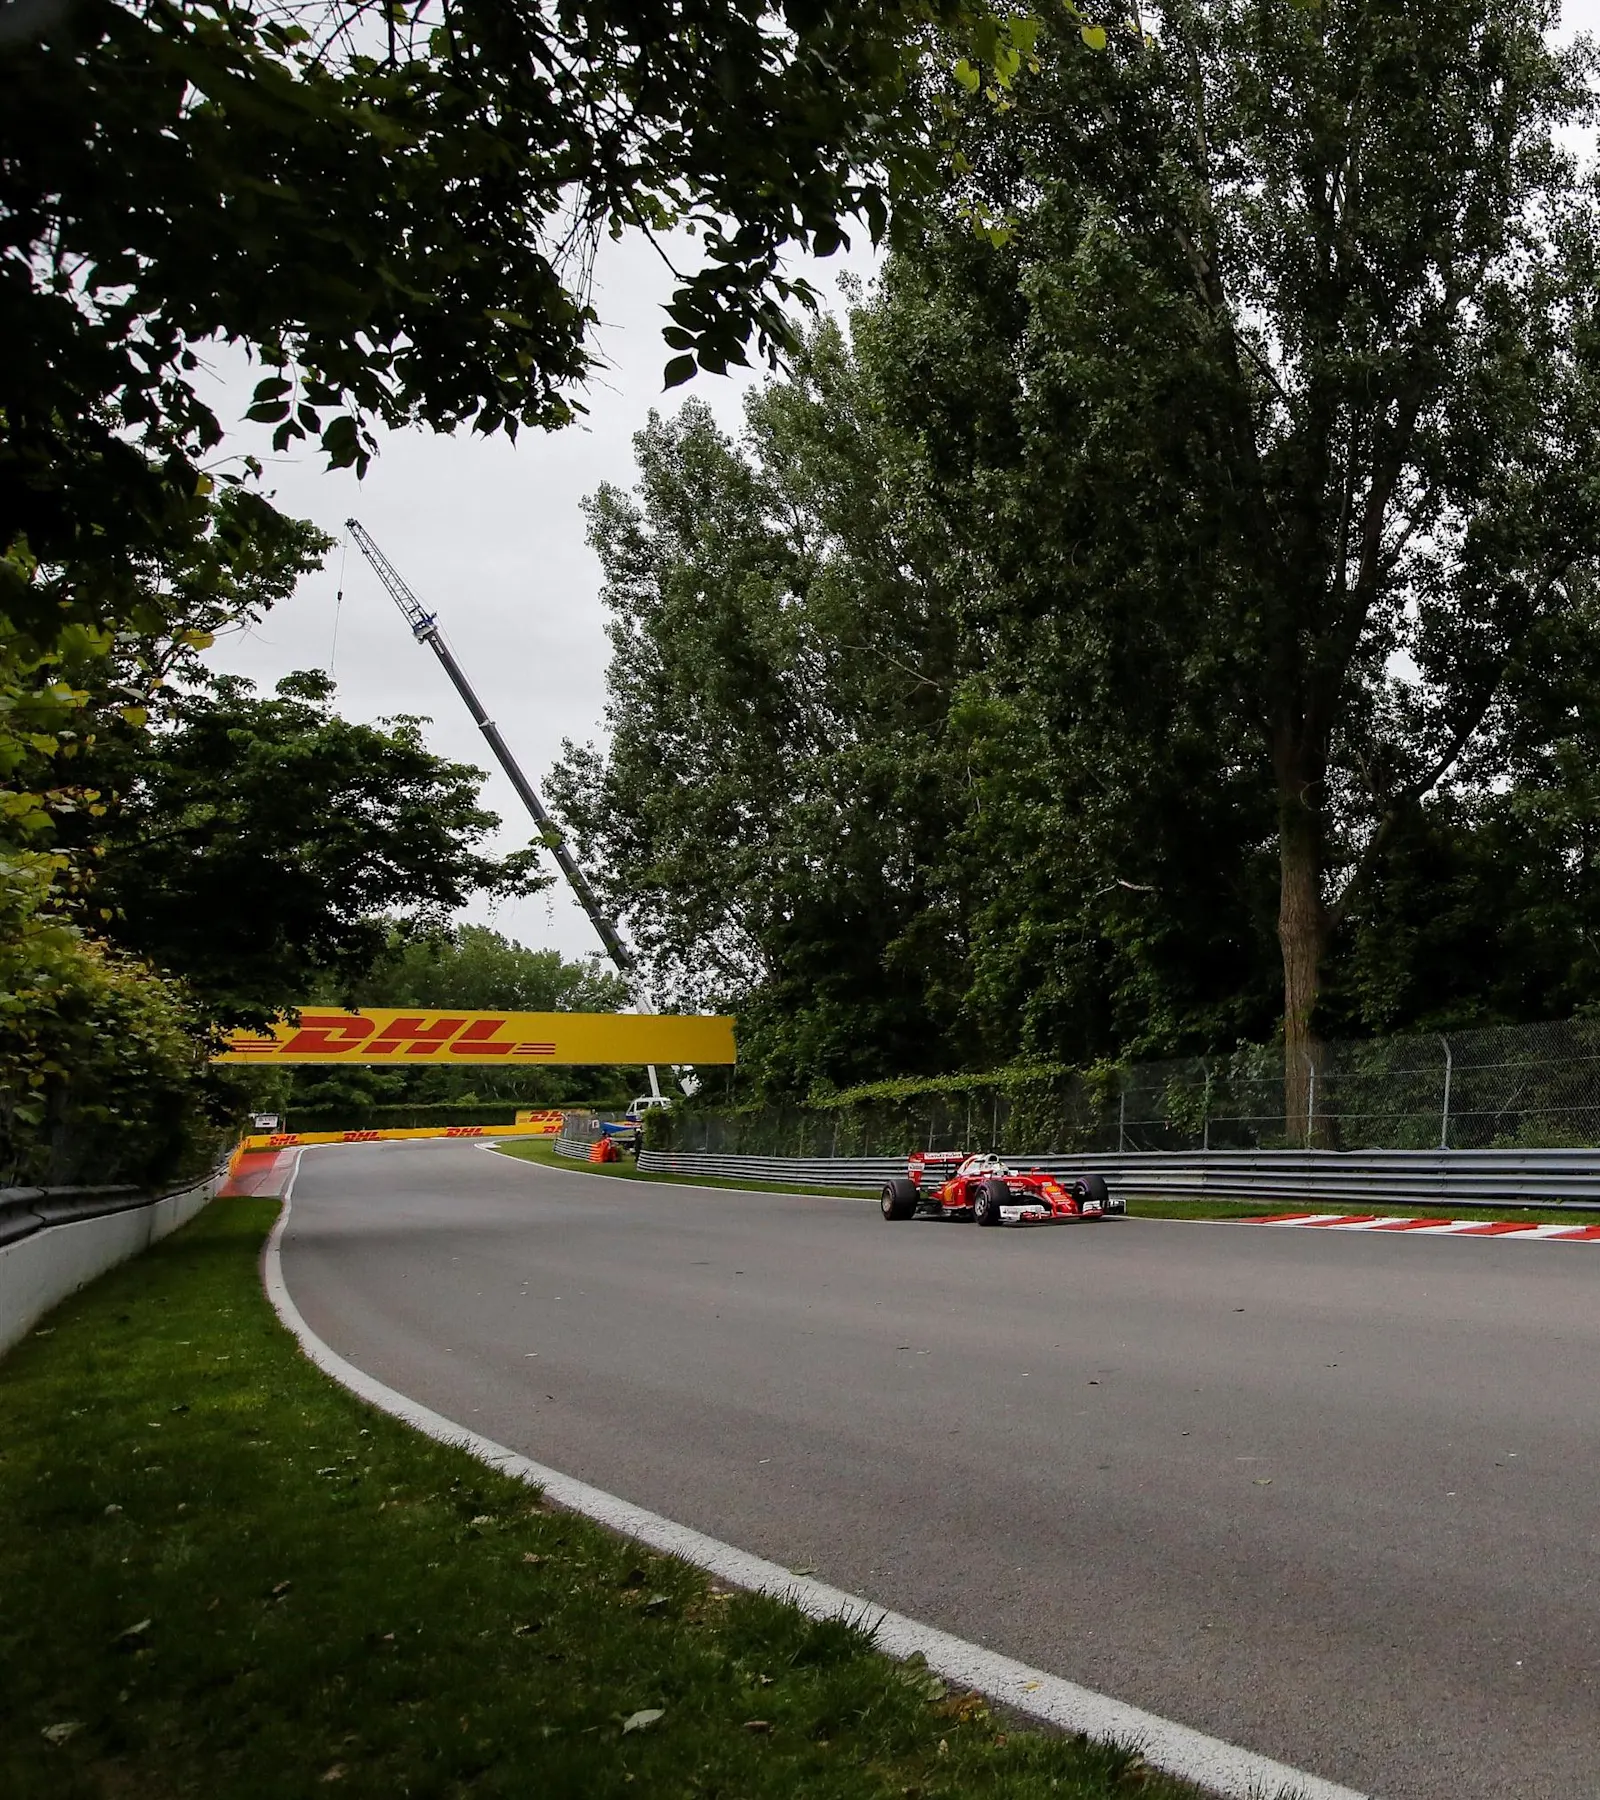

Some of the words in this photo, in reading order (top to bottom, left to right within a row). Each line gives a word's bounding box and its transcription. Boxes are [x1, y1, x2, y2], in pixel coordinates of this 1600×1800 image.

[278, 1016, 518, 1054] DHL
[529, 1110, 563, 1122] DH
[342, 1131, 382, 1143] DHL
[445, 1127, 484, 1137] DHL
[268, 1135, 299, 1146] DHL
